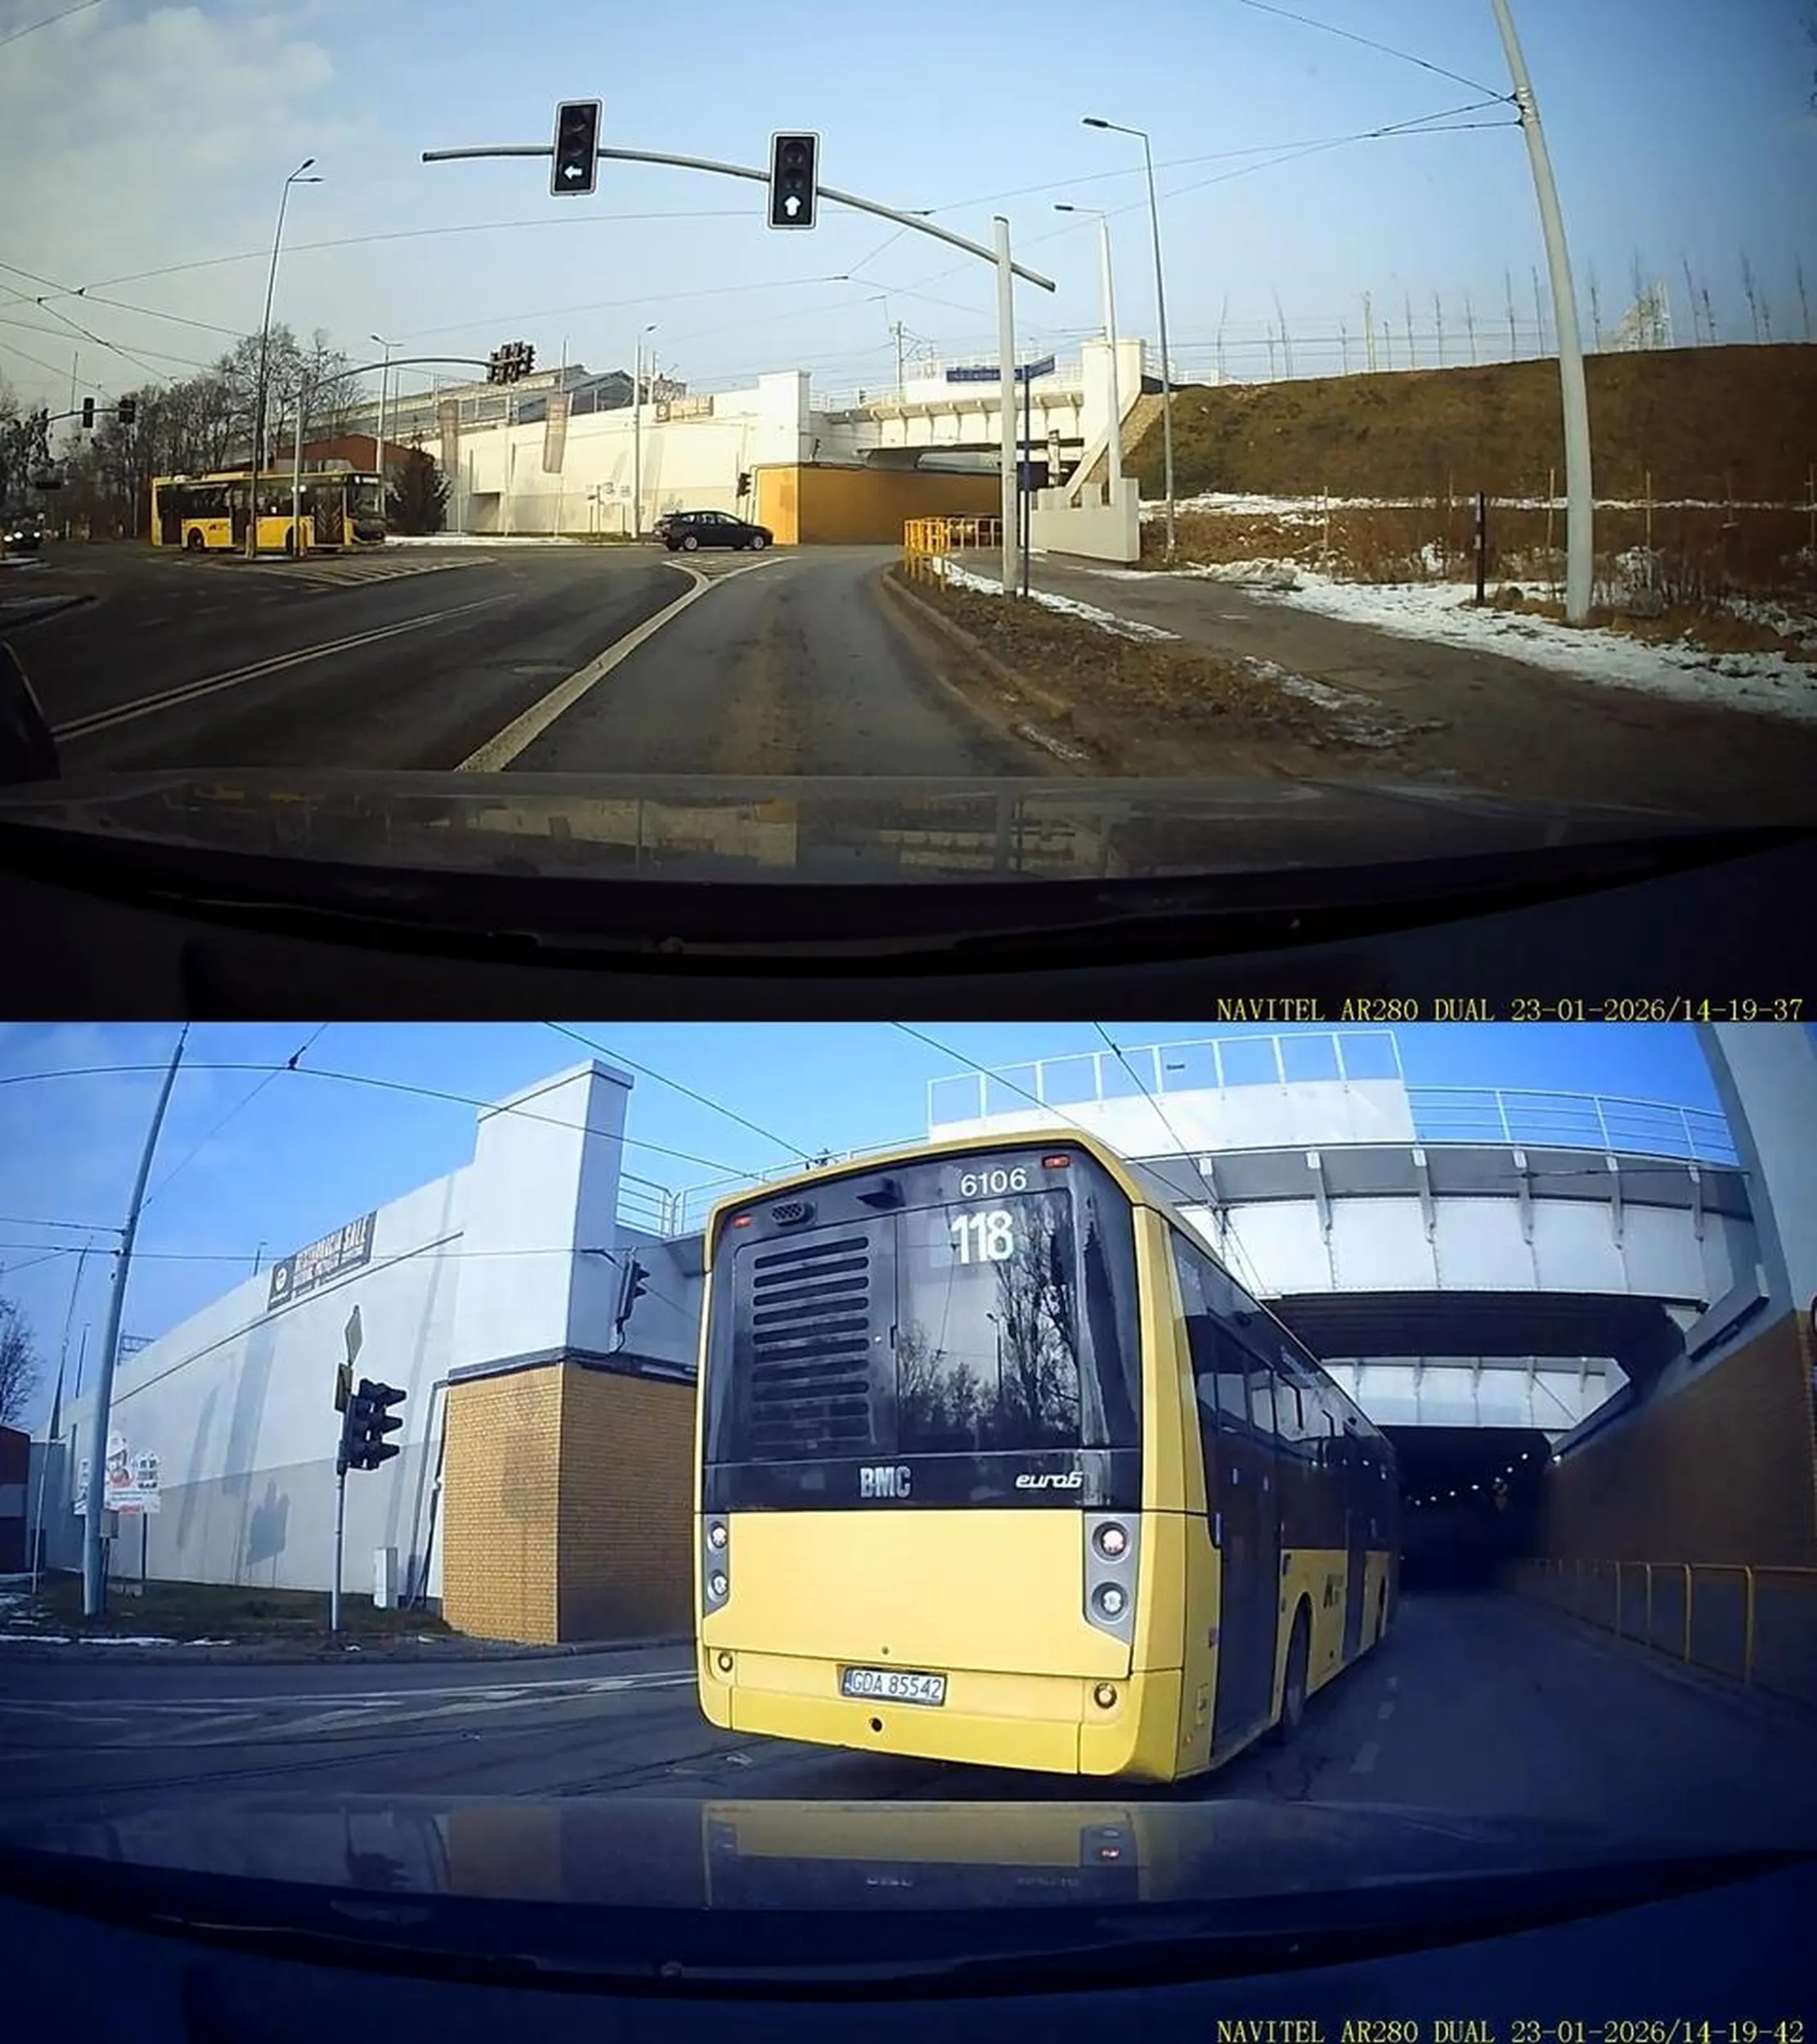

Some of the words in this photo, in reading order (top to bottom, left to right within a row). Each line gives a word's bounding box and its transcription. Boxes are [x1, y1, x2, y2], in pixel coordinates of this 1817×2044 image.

[961, 1168, 1027, 1197] 6106
[951, 1210, 1014, 1264] 118
[860, 1466, 911, 1498] BMC
[1016, 1471, 1083, 1489] euro6
[853, 1672, 883, 1693] GDA
[889, 1674, 942, 1699] 85542
